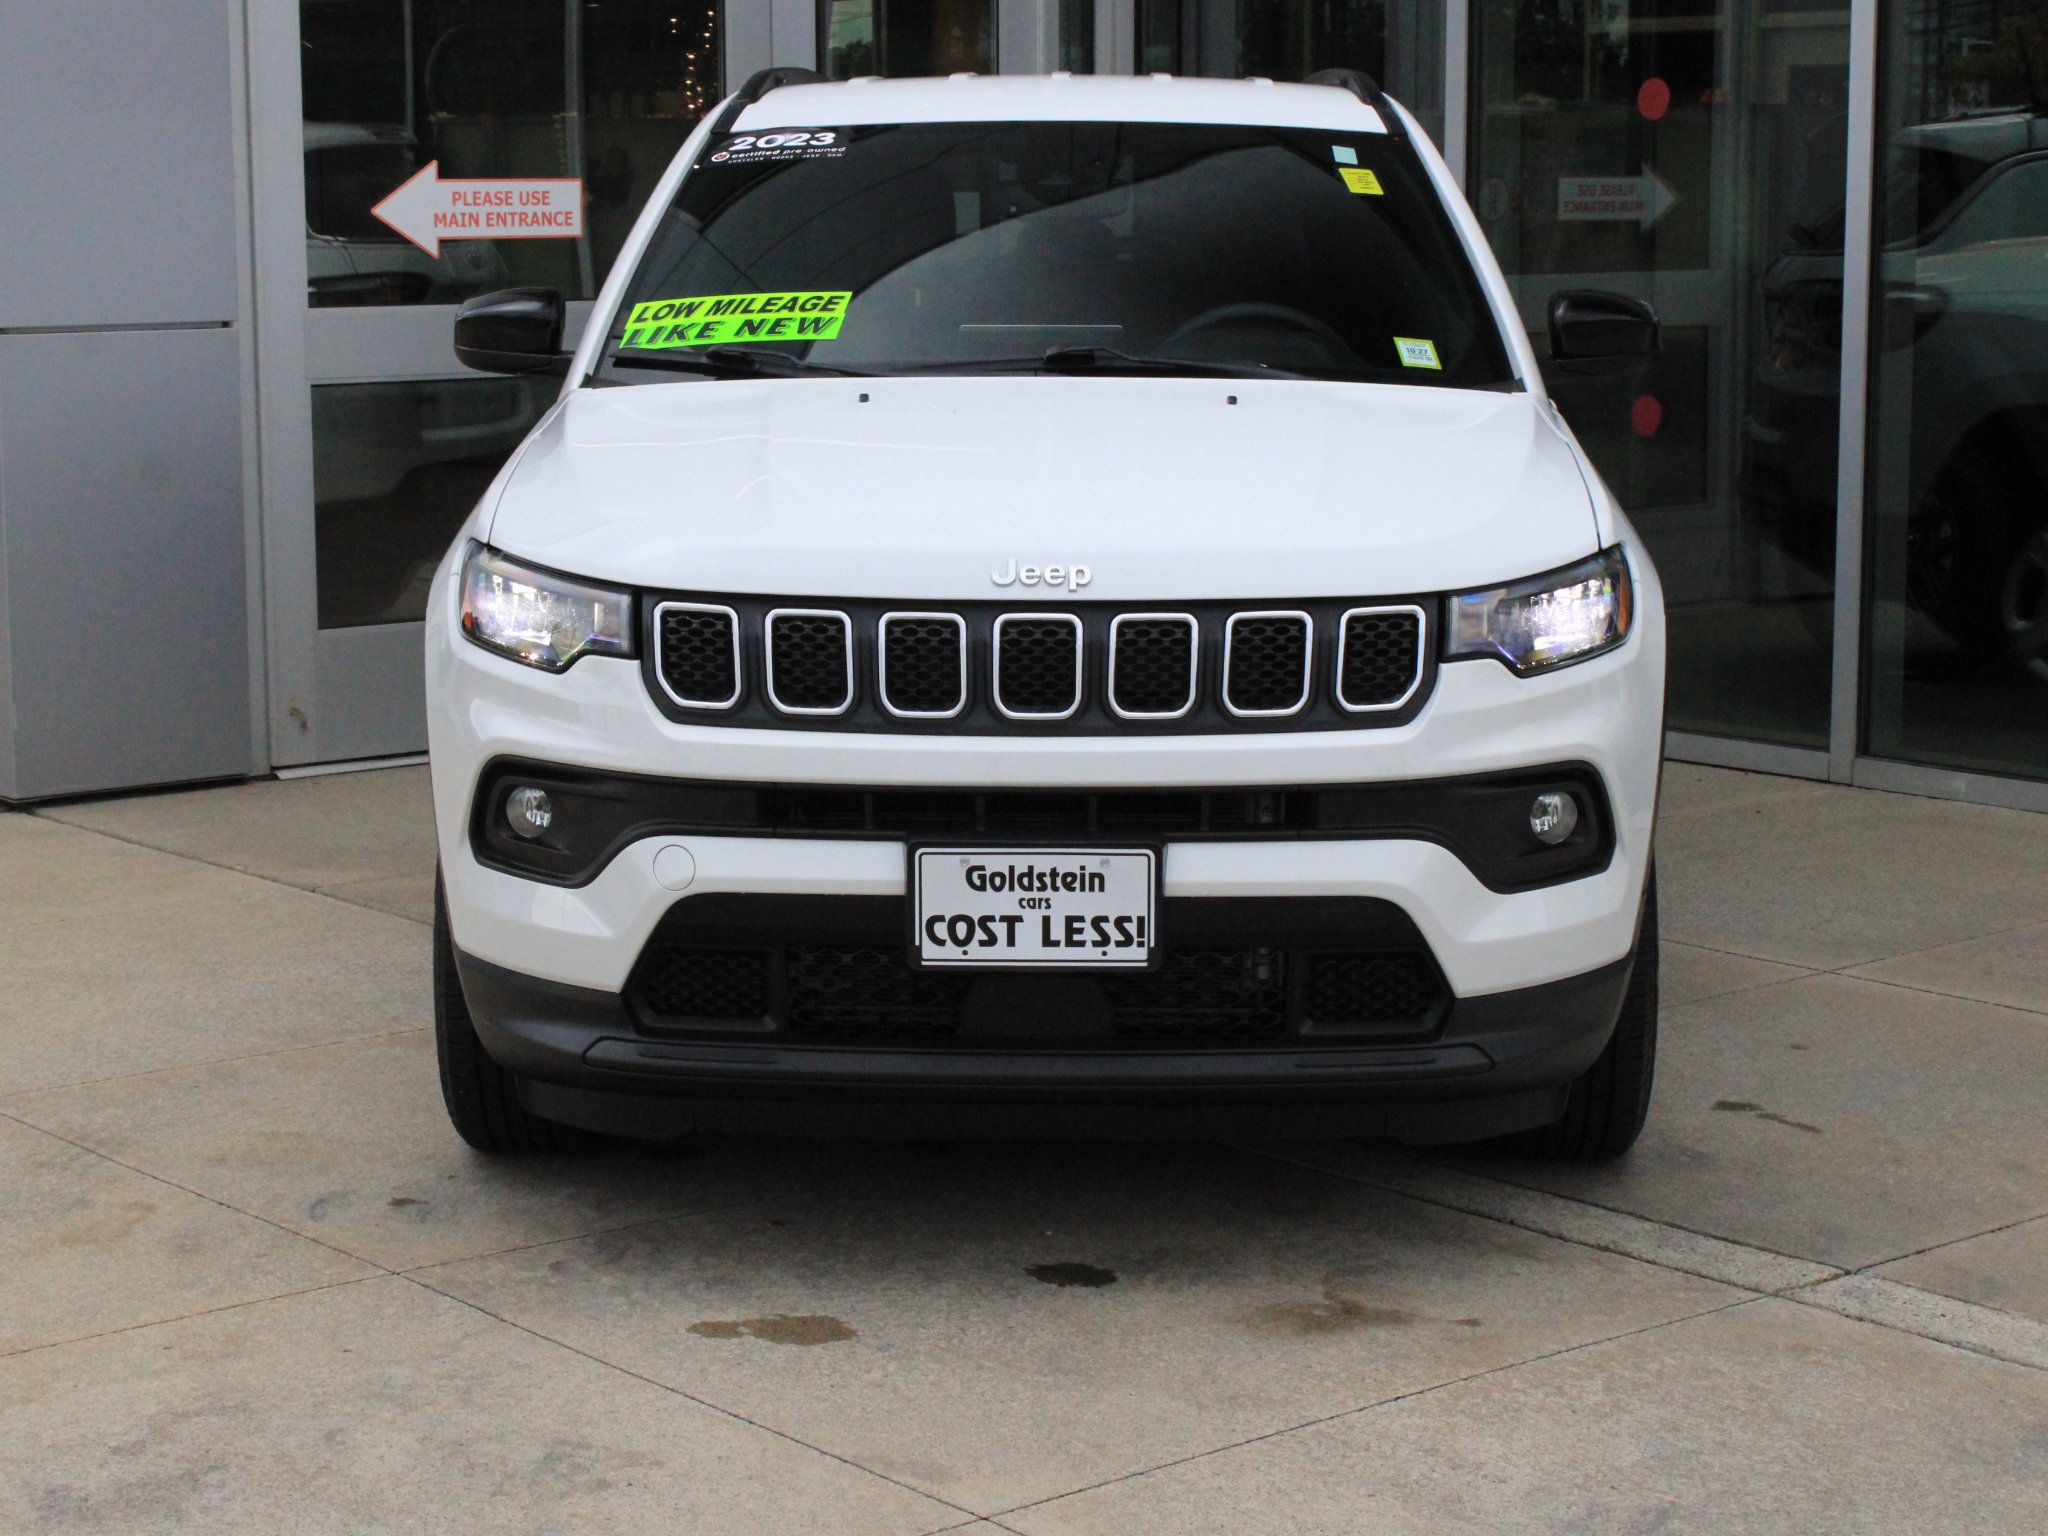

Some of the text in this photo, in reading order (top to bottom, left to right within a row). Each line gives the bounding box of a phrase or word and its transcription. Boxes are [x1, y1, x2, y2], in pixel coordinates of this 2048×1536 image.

[728, 132, 836, 151] 2023
[731, 149, 780, 159] certified
[452, 190, 550, 207] PLEASE USE
[434, 211, 573, 228] MAIN ENTRANCE
[633, 295, 846, 324] LOW MILEAGE
[623, 316, 840, 346] LIKE NEW
[991, 558, 1092, 593] Jeep
[965, 865, 1105, 892] Goldstein
[1018, 897, 1052, 910] cars
[925, 914, 1146, 948] COST LESS!
